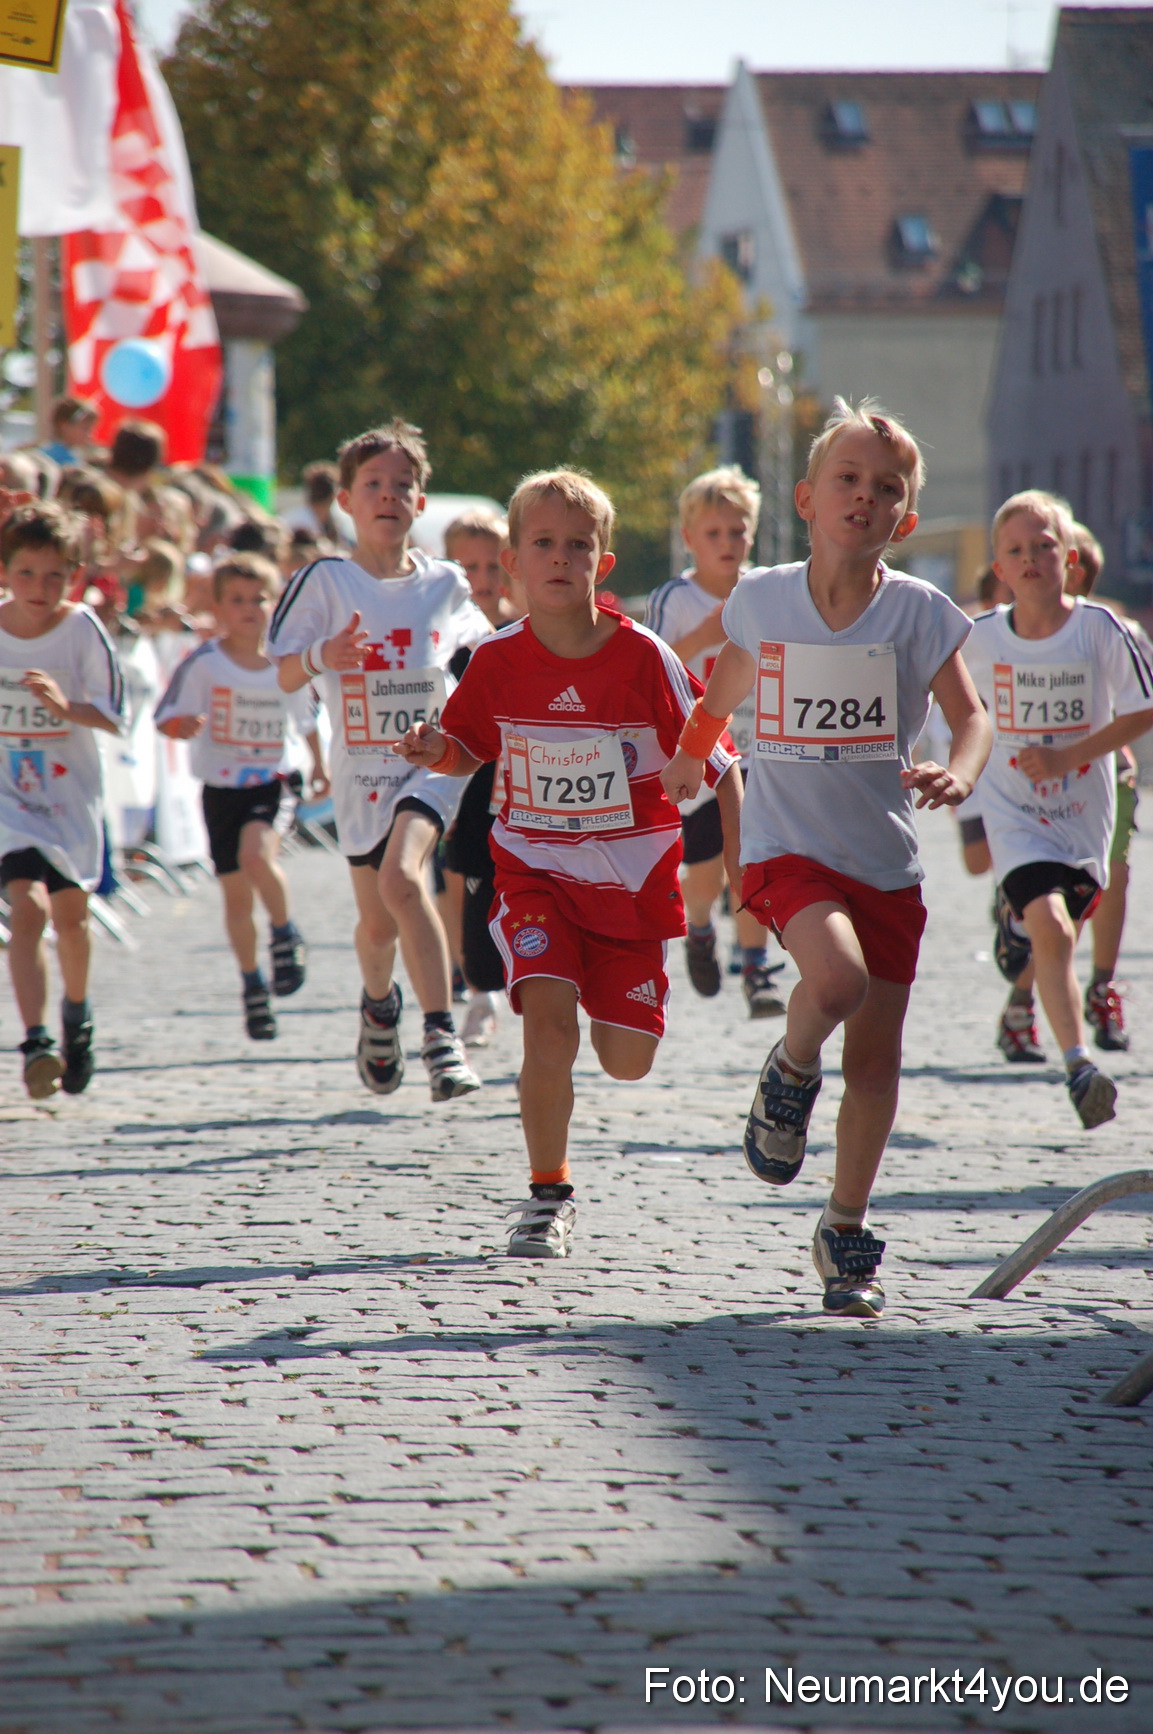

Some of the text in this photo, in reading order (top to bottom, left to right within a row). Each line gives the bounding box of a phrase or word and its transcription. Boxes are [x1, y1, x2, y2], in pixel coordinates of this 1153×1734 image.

[371, 680, 435, 697] Johannes
[1049, 672, 1085, 690] julian
[548, 701, 586, 713] adidas
[793, 696, 886, 730] 7284
[1020, 699, 1085, 724] 7138
[236, 719, 284, 740] 7013
[530, 744, 601, 767] Christoph
[757, 741, 895, 756] BOCK PFLEIDERER
[536, 770, 616, 804] 7297
[511, 810, 631, 825] BOCK PFLEIDERER
[626, 991, 658, 1008] adidas
